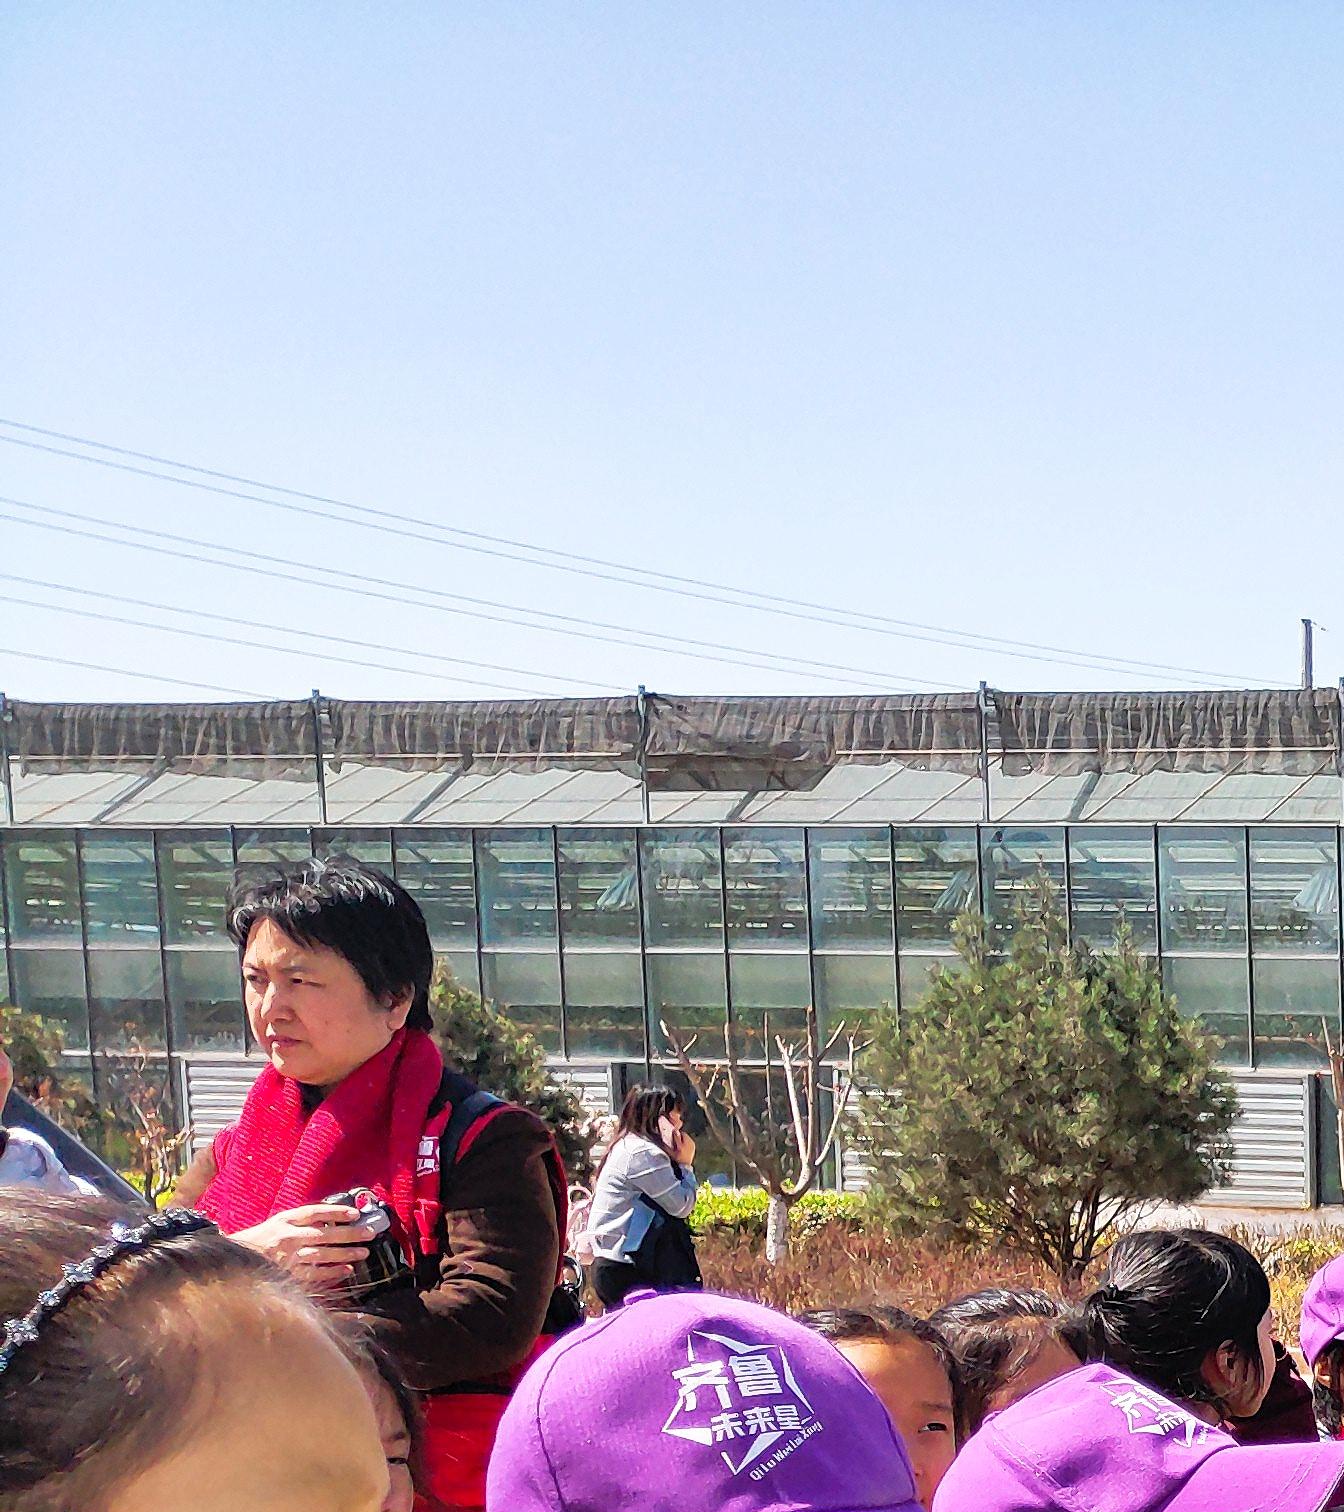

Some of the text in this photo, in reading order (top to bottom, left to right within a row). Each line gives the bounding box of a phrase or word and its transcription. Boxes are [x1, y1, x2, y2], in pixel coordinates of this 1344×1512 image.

[672, 1354, 783, 1411] 齐鲁
[710, 1404, 802, 1442] 未来星
